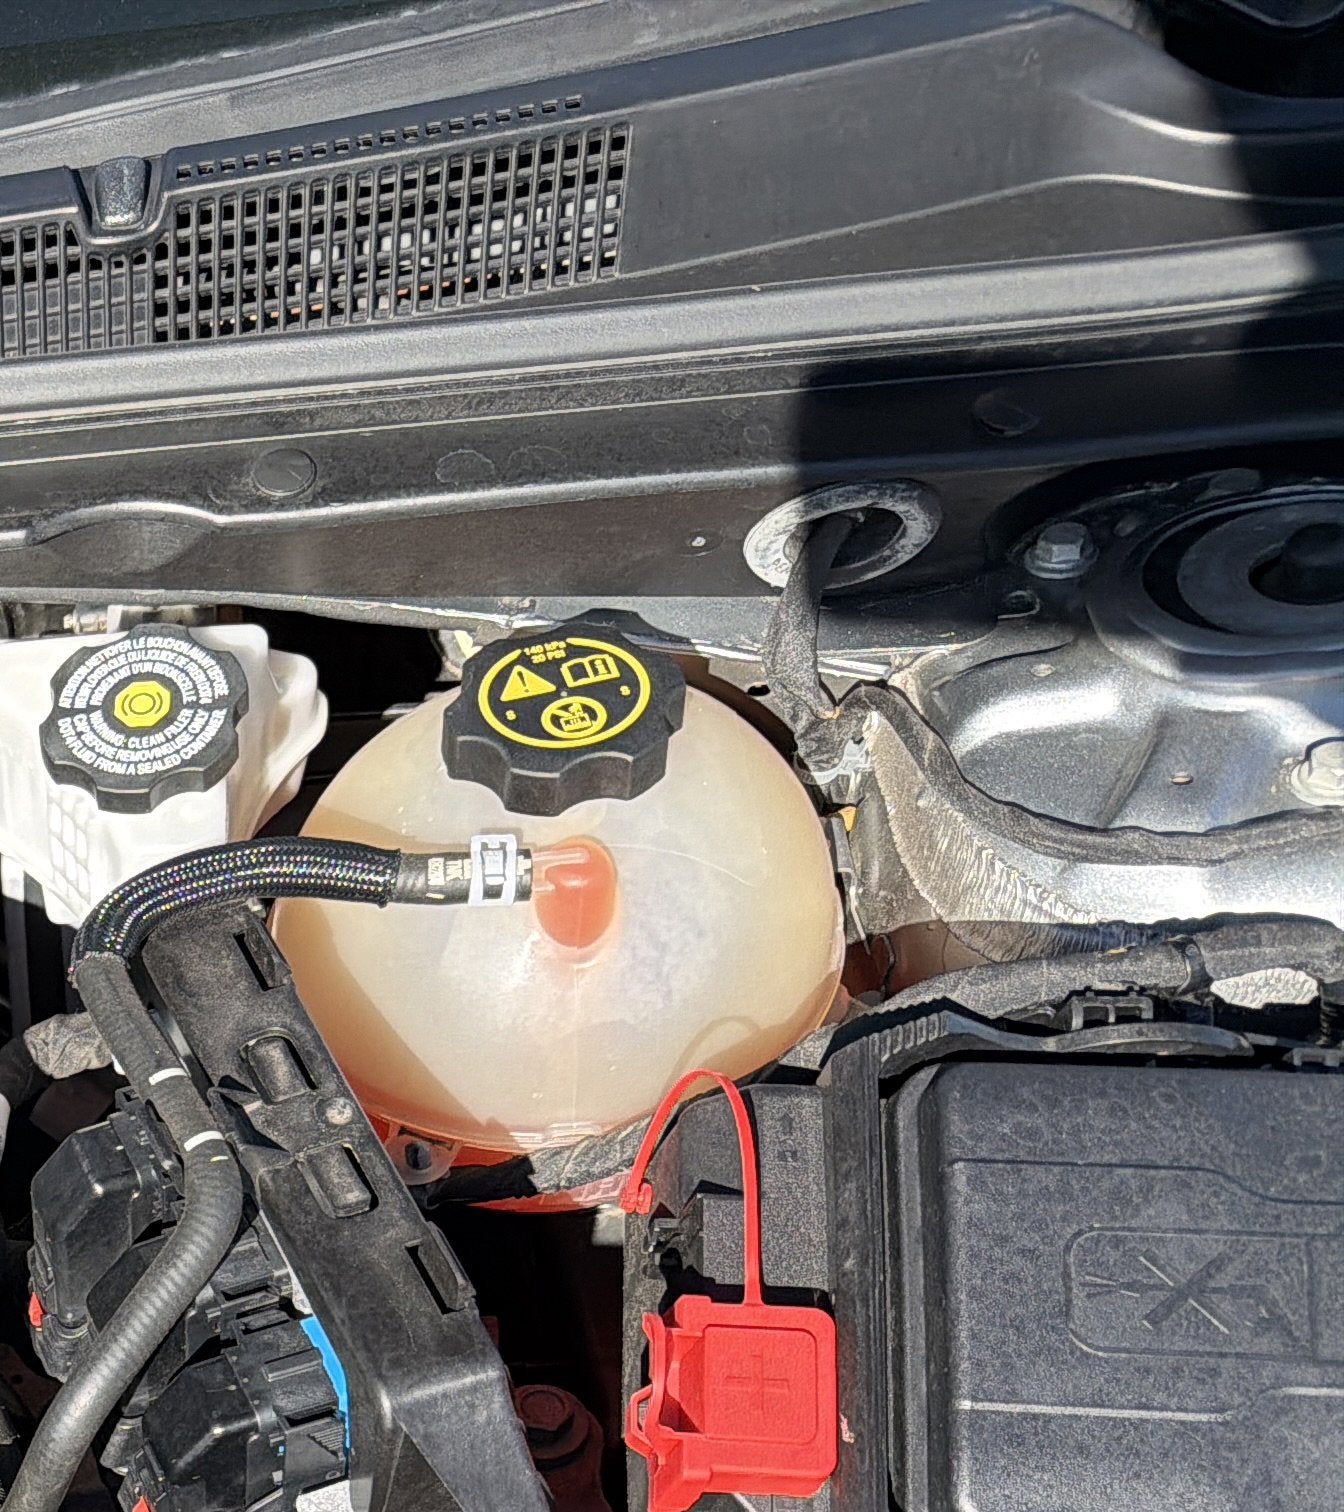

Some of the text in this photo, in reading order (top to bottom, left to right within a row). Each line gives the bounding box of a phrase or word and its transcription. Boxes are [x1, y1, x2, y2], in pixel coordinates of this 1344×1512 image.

[125, 731, 167, 749] CLEAN
[162, 707, 194, 739] FILLER
[91, 755, 128, 775] FROM
[136, 752, 183, 775] SEALED
